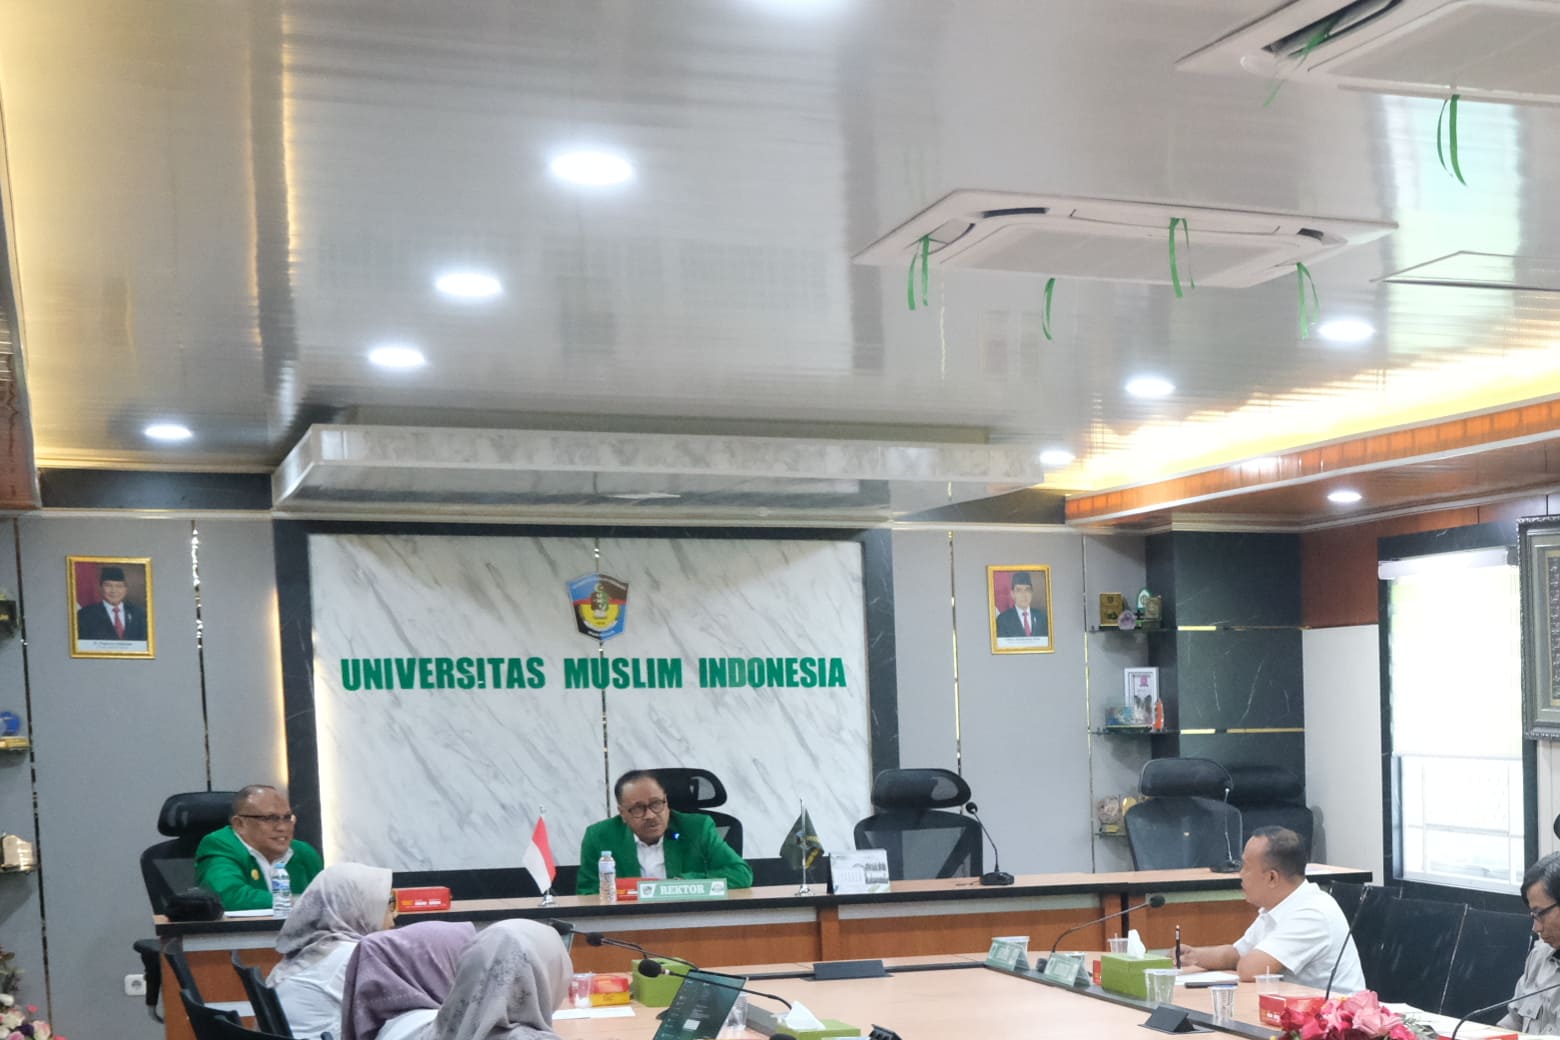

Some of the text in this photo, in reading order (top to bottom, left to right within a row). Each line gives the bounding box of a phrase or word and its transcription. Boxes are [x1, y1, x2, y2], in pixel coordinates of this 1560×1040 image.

[340, 656, 847, 691] UNIVERSITAS MUSLIM INDONESIA
[660, 885, 704, 895] REKTOR
